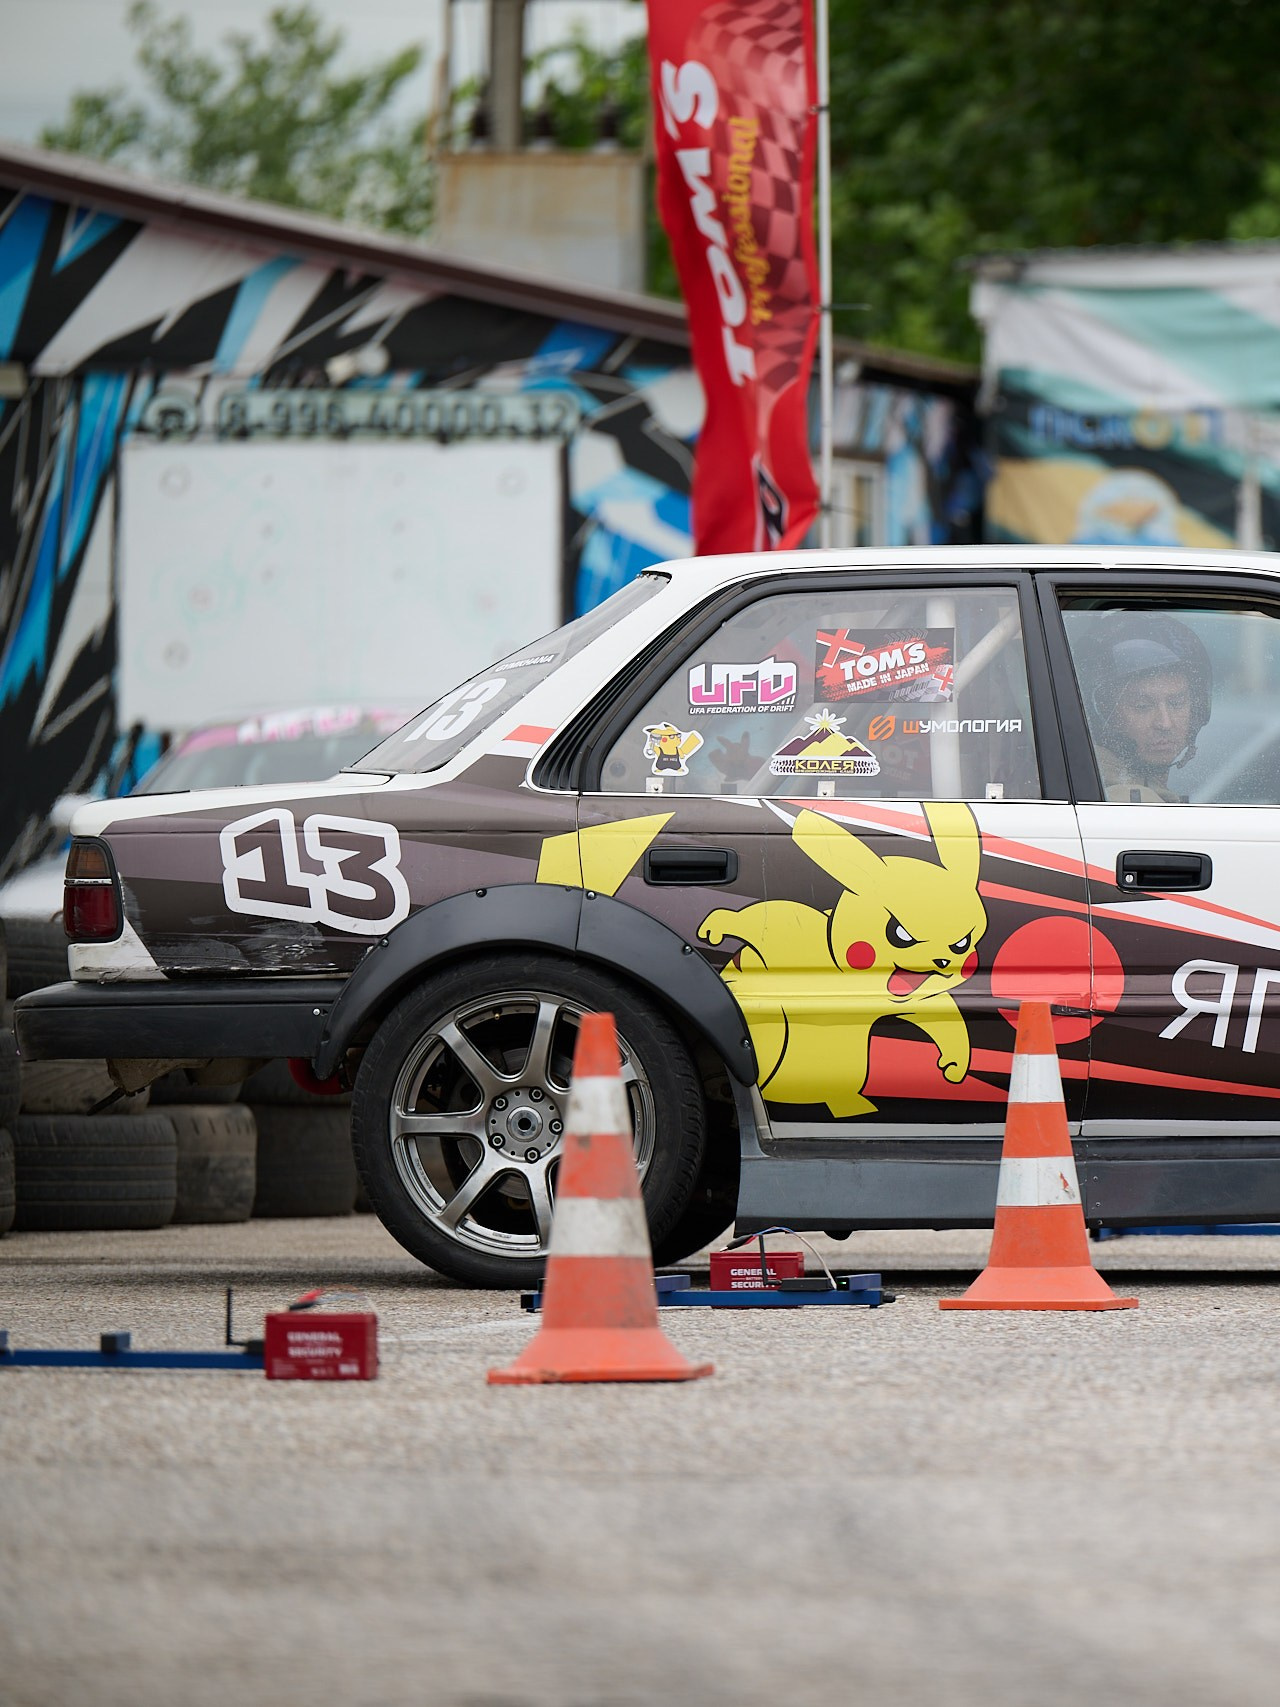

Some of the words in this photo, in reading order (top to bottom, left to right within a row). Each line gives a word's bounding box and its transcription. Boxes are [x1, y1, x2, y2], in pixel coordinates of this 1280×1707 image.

[658, 58, 757, 388] TOM'S
[840, 641, 925, 680] TOM'S
[847, 677, 877, 692] MADE
[879, 674, 892, 684] IN
[895, 663, 929, 680] JAPAN
[690, 657, 796, 706] UFD
[403, 678, 507, 742] 13
[903, 719, 1022, 734] ШУМОЛОГИЯ
[795, 760, 854, 770] КОЛЕЯ
[220, 808, 410, 936] 13
[287, 1331, 342, 1343] GENERAL
[288, 1346, 343, 1357] SECURITY
